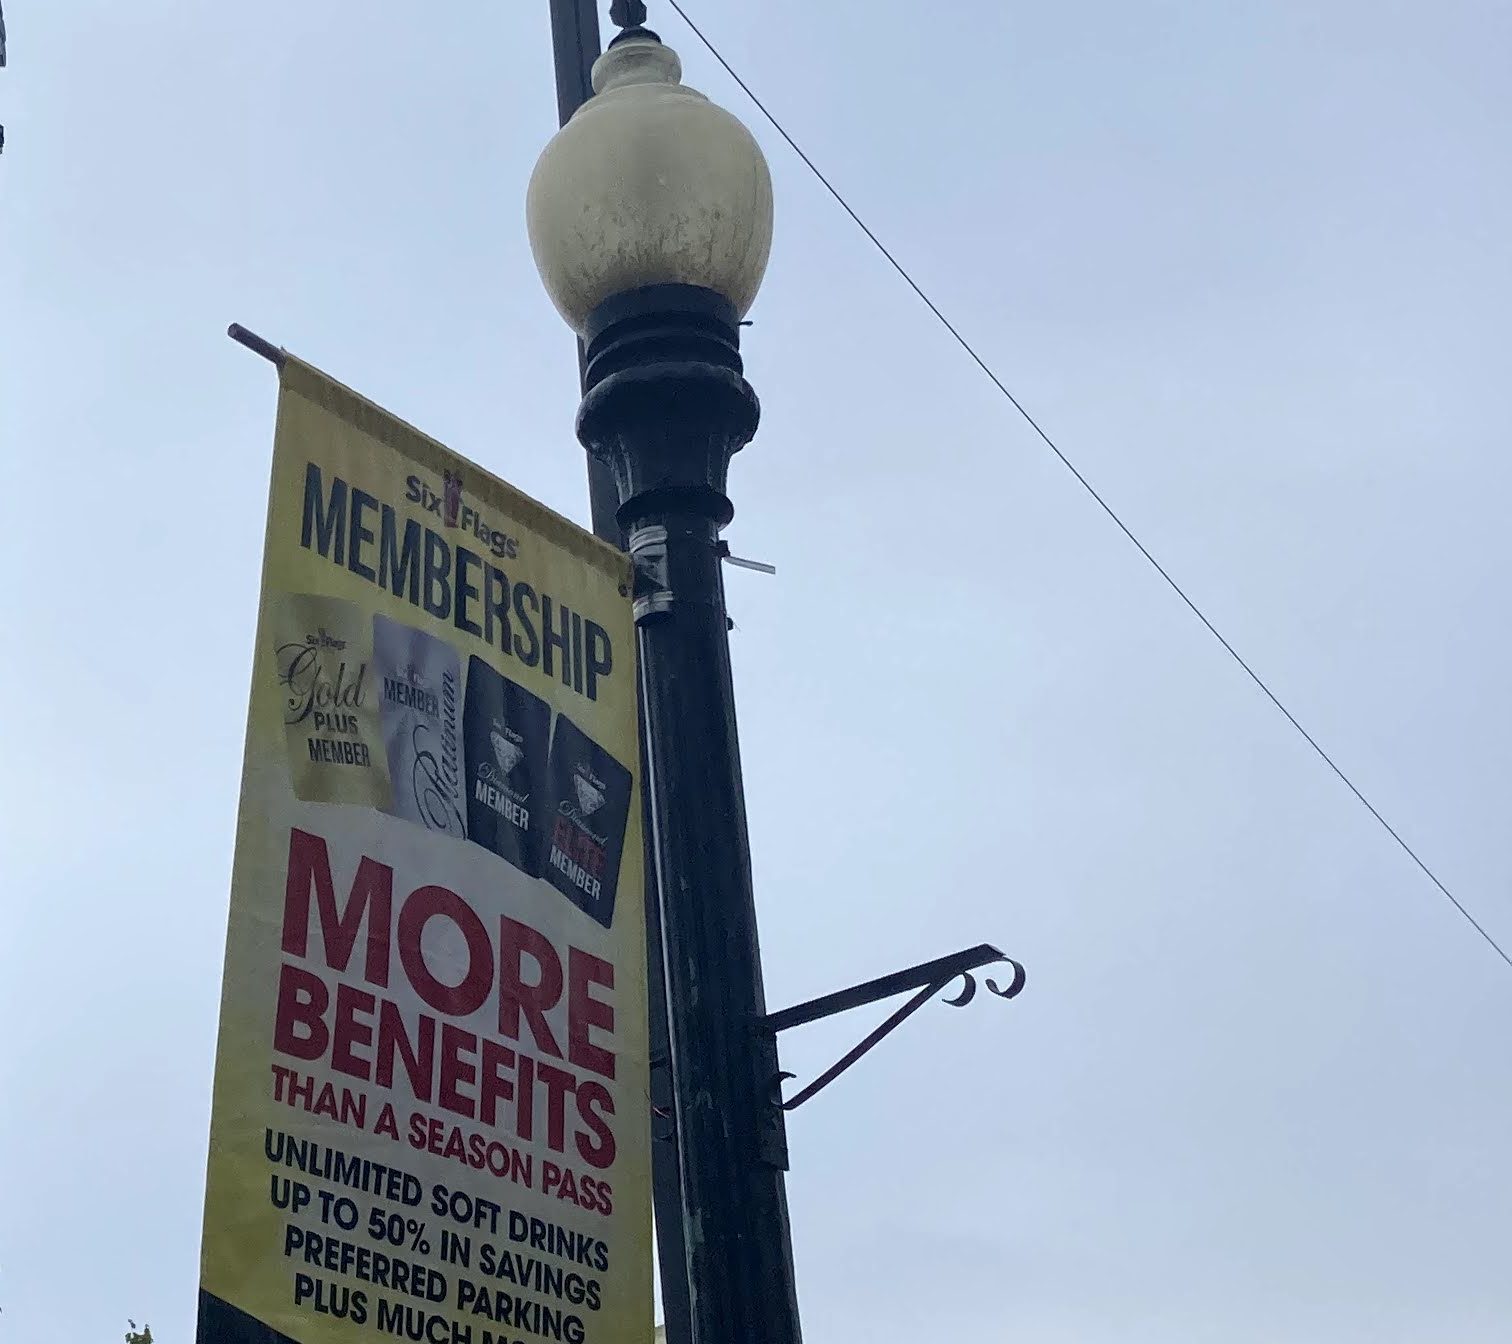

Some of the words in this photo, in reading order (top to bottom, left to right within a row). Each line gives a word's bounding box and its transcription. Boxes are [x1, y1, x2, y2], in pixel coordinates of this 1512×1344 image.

[406, 475, 443, 518] Six
[461, 506, 518, 559] Flags
[301, 462, 613, 701] MEMBERSHIP
[276, 644, 367, 725] Gold
[314, 711, 358, 735] PLUS
[384, 676, 439, 718] MEMBER
[308, 738, 371, 768] MEMBER
[412, 669, 467, 842] Platinum
[475, 779, 529, 831] MEMBER
[549, 845, 602, 900] MEMBER
[281, 827, 616, 1080] MORE
[273, 962, 617, 1169] BENEFITS
[271, 1063, 366, 1130] THAN
[373, 1102, 399, 1142] A
[408, 1111, 533, 1189] SEASON
[542, 1162, 613, 1216] PASS
[264, 1128, 422, 1207] UNLIMITED
[431, 1184, 502, 1234] SOFT
[509, 1214, 609, 1272] DRINKS
[271, 1174, 311, 1213] UP
[318, 1191, 359, 1230] TO
[367, 1209, 431, 1255] 50%
[440, 1229, 472, 1266] IN
[479, 1242, 602, 1311] SAVINGS
[284, 1224, 447, 1304] PREFERRED
[294, 1272, 368, 1324] PLUS
